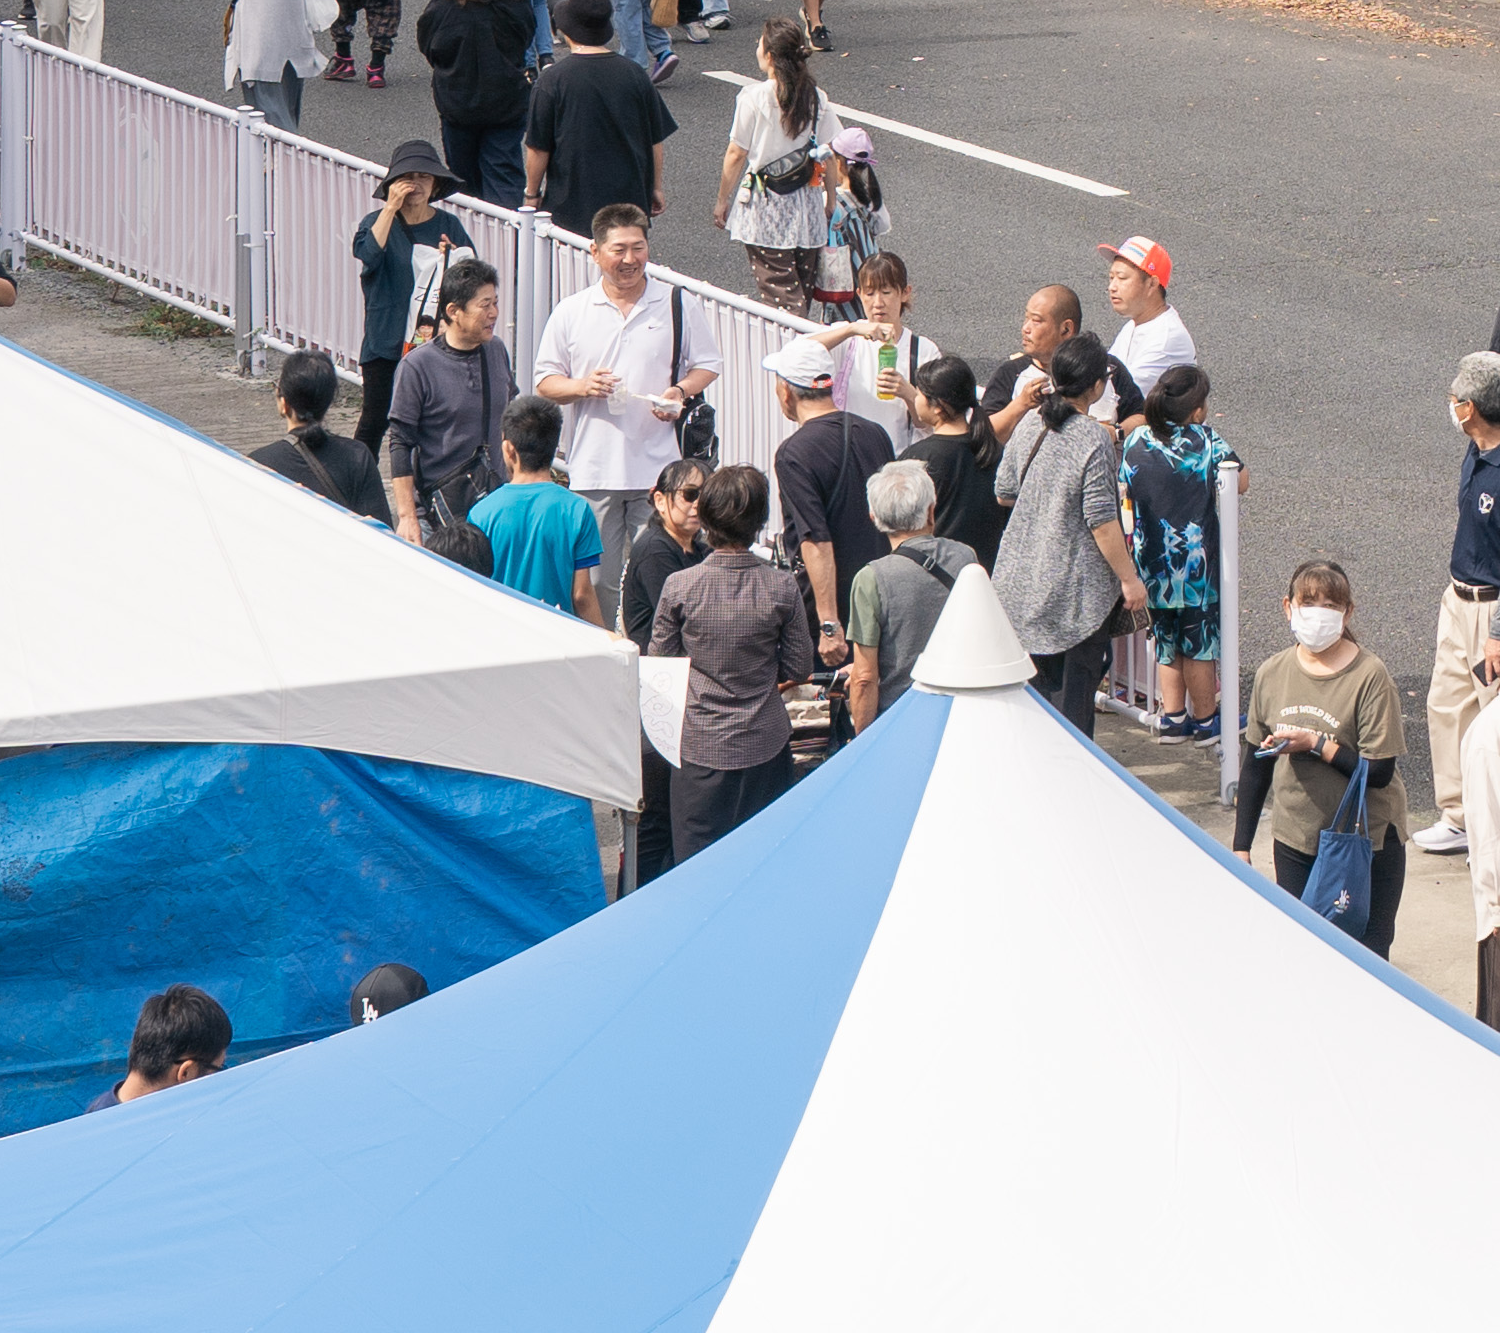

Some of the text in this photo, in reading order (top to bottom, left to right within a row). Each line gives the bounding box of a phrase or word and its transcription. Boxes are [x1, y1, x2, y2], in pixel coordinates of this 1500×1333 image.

[1279, 704, 1341, 730] THE WORLD HAS
